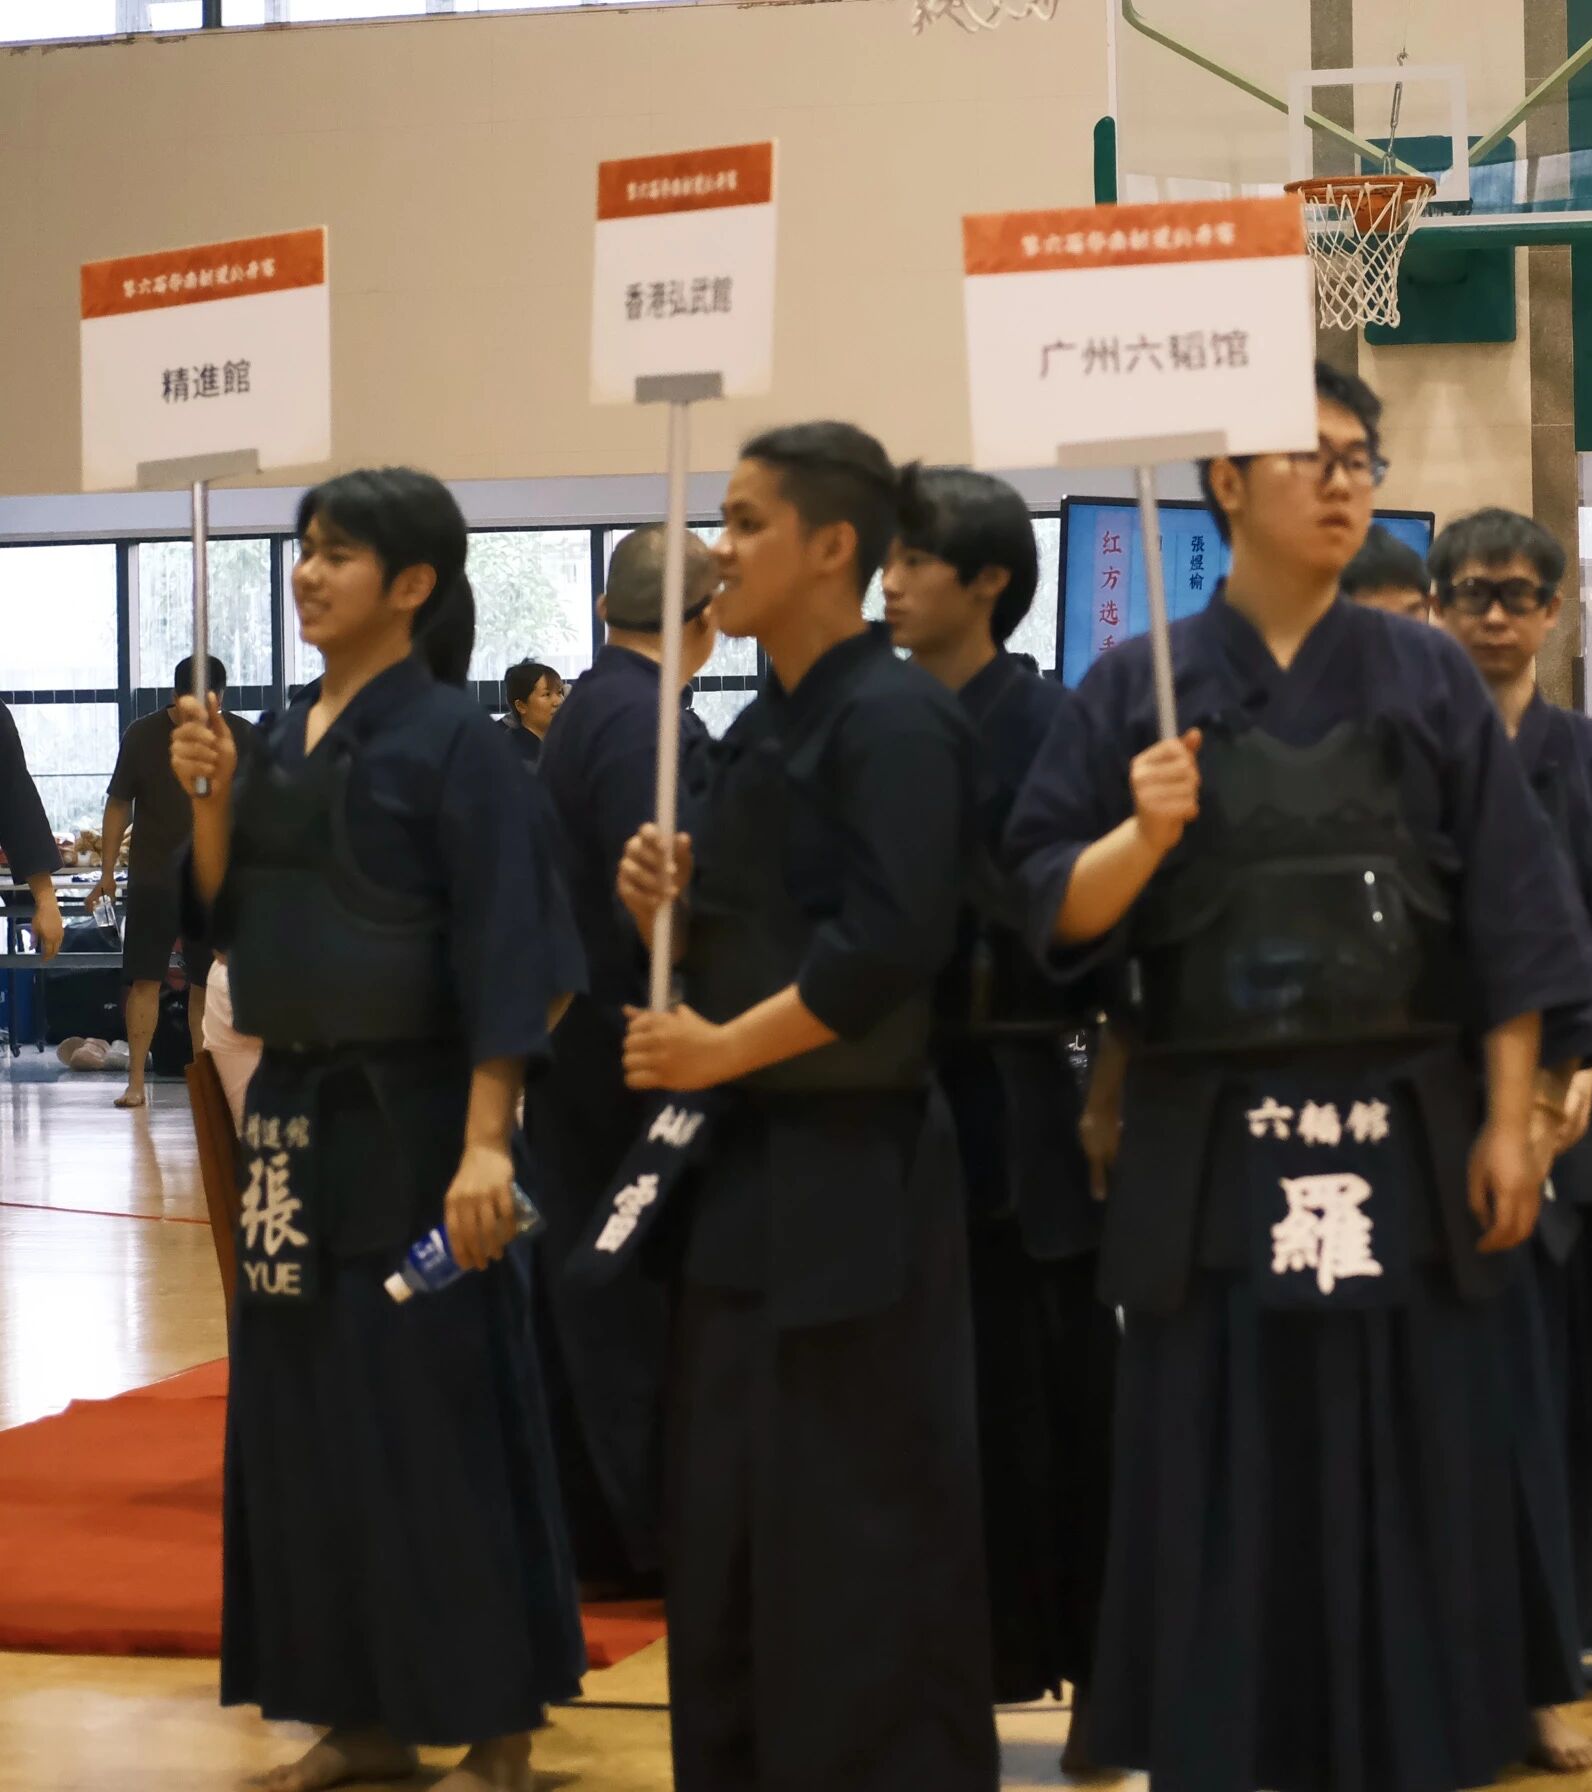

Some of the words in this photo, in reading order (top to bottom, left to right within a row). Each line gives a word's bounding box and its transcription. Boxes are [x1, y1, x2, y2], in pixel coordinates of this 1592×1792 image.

[1039, 329, 1250, 380] 广州六韬馆
[161, 359, 252, 404] 精進館
[240, 1151, 309, 1257] 張
[1270, 1171, 1384, 1295] 羅
[243, 1262, 302, 1295] YUE
